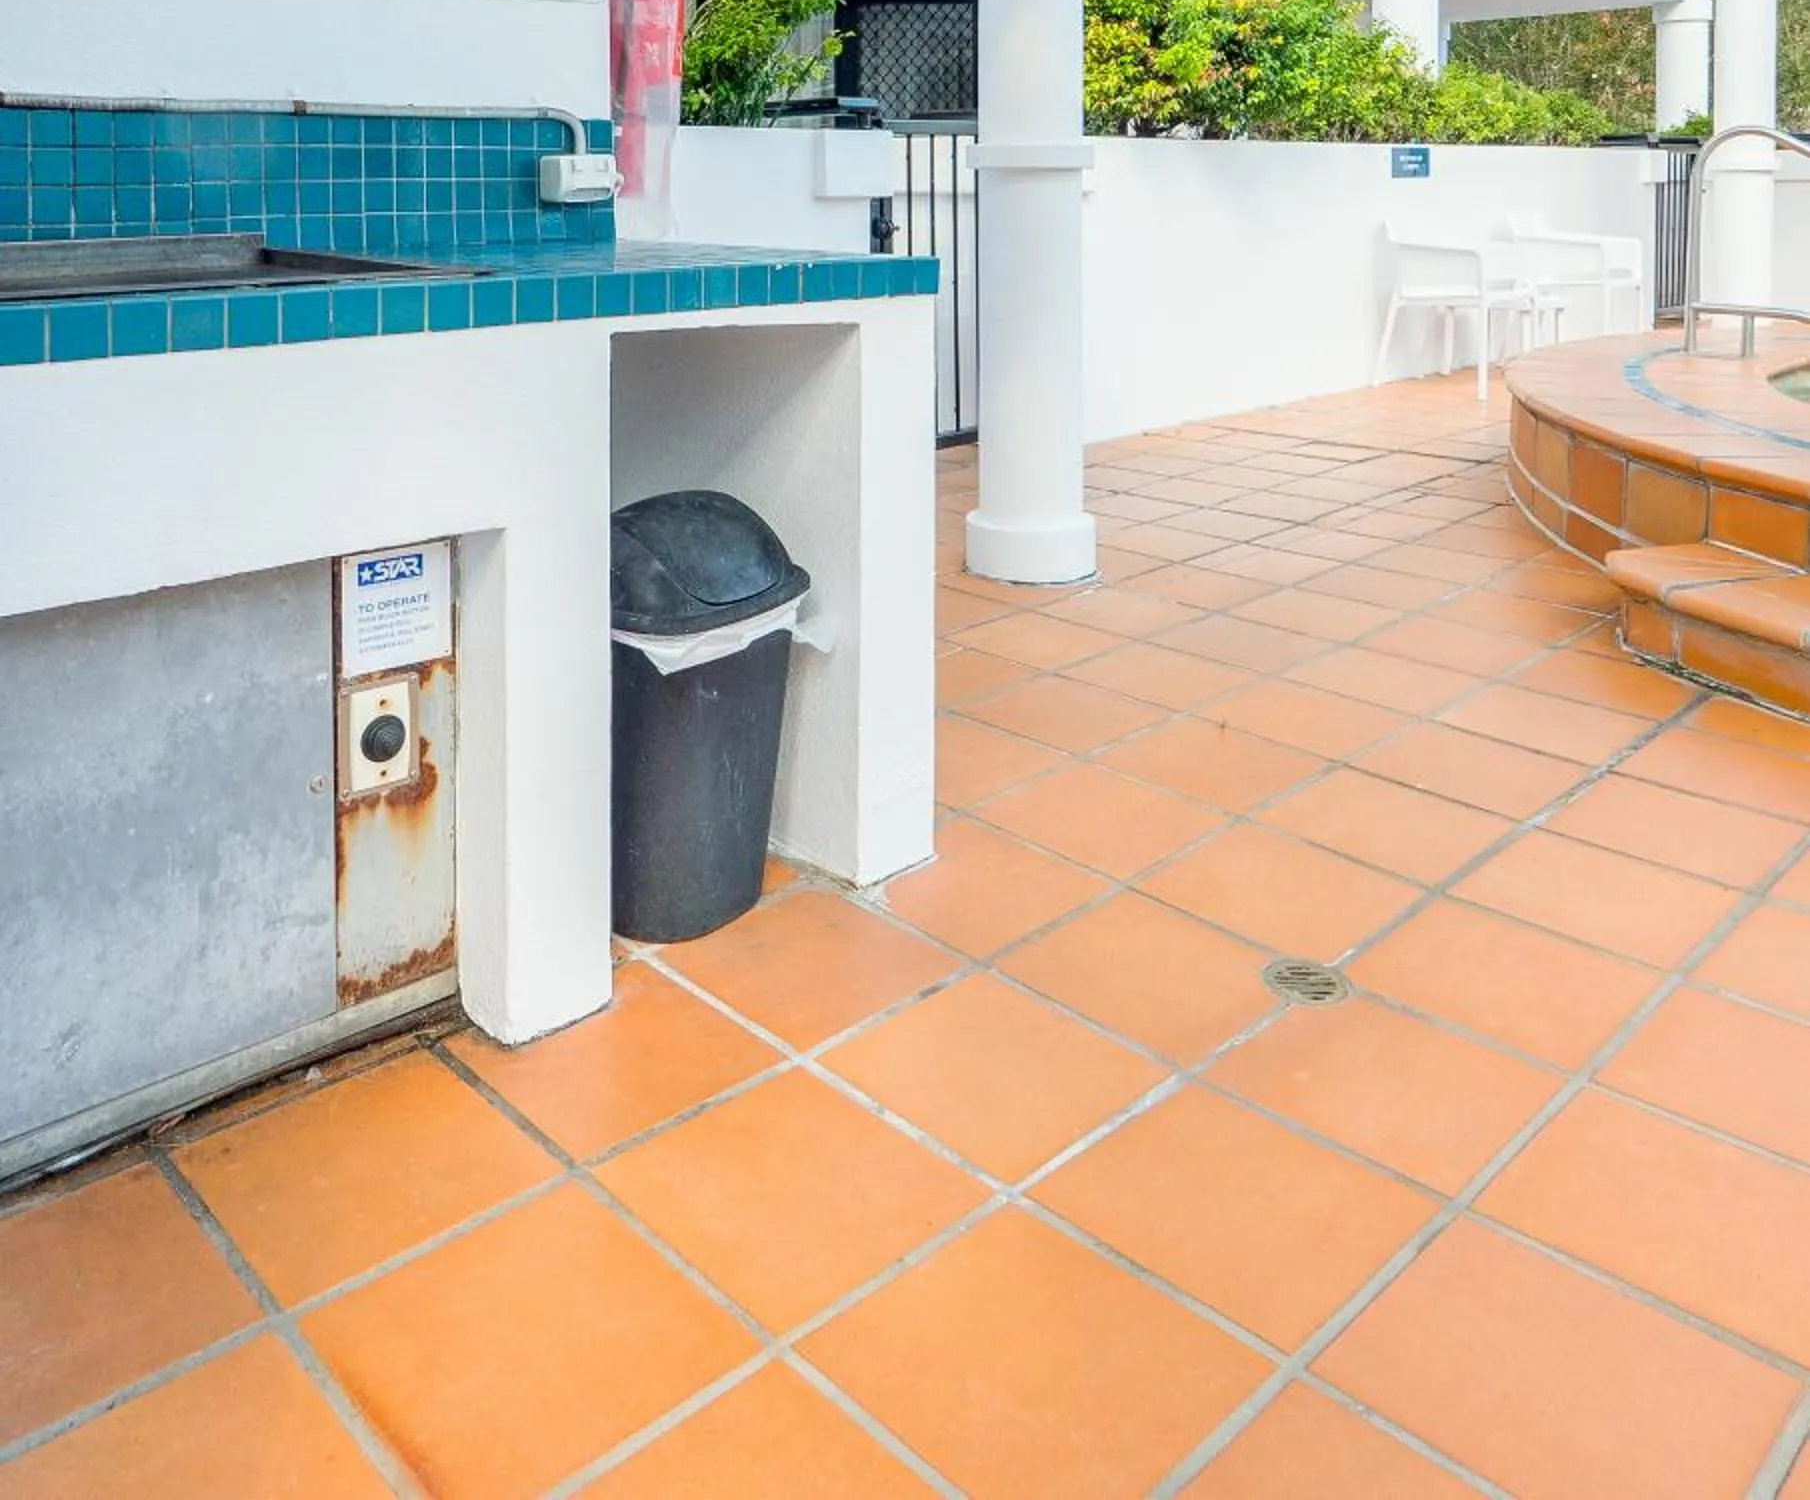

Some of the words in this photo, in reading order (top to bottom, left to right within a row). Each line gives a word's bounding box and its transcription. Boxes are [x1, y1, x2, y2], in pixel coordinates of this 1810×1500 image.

[374, 557, 420, 581] STAR
[357, 602, 375, 613] TO
[377, 594, 430, 611] OPERATE
